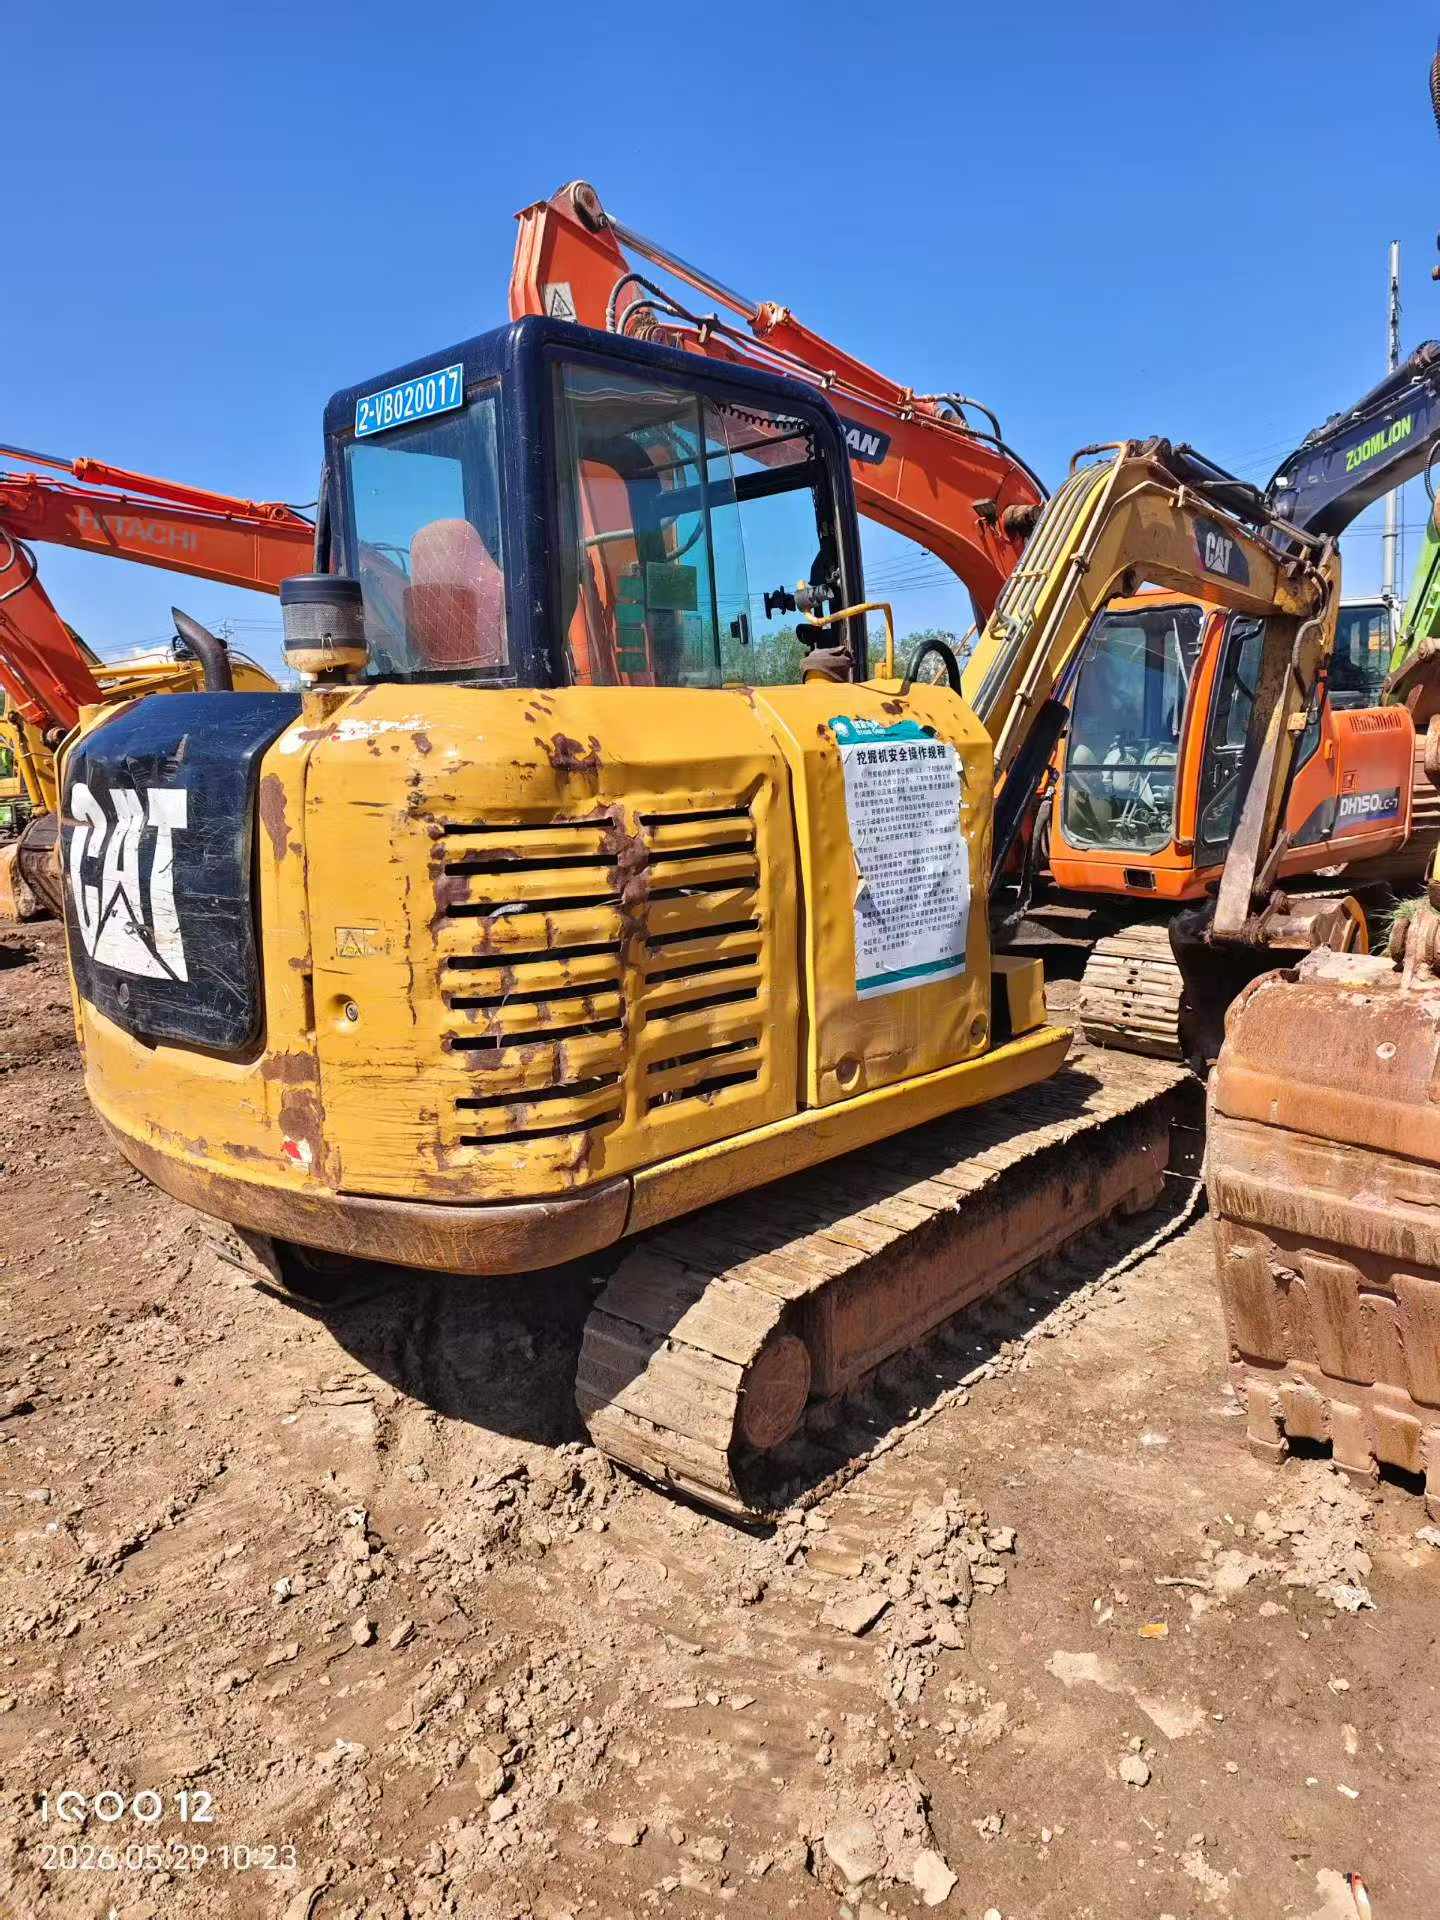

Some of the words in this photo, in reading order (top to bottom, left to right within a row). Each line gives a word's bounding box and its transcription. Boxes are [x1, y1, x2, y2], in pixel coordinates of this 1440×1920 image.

[359, 371, 459, 430] 2-VB020017
[1204, 531, 1233, 575] CAT
[857, 745, 946, 765] 挖掘机安全操作规程
[70, 782, 189, 982] CAT
